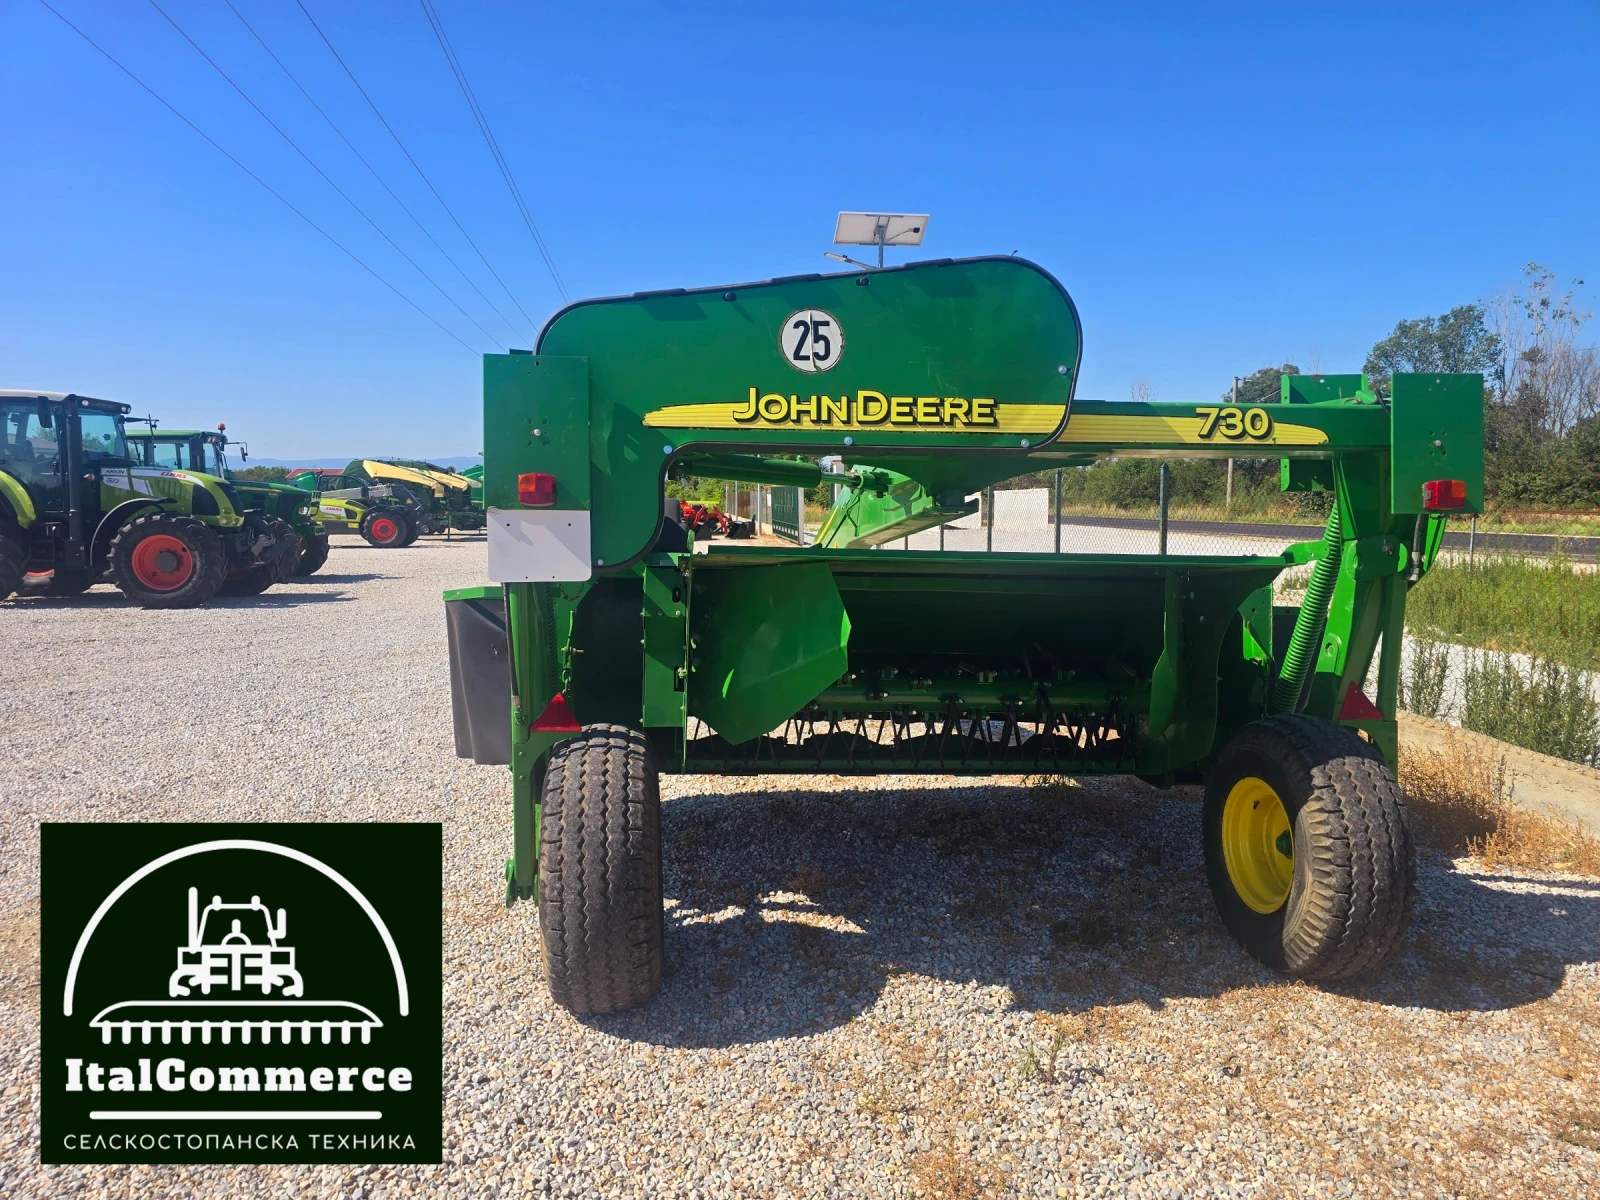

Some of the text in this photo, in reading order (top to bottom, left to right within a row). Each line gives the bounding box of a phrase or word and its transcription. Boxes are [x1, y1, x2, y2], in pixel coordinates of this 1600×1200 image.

[793, 319, 831, 361] 25
[733, 386, 998, 427] JOHN DEERE
[1195, 407, 1273, 440] 730
